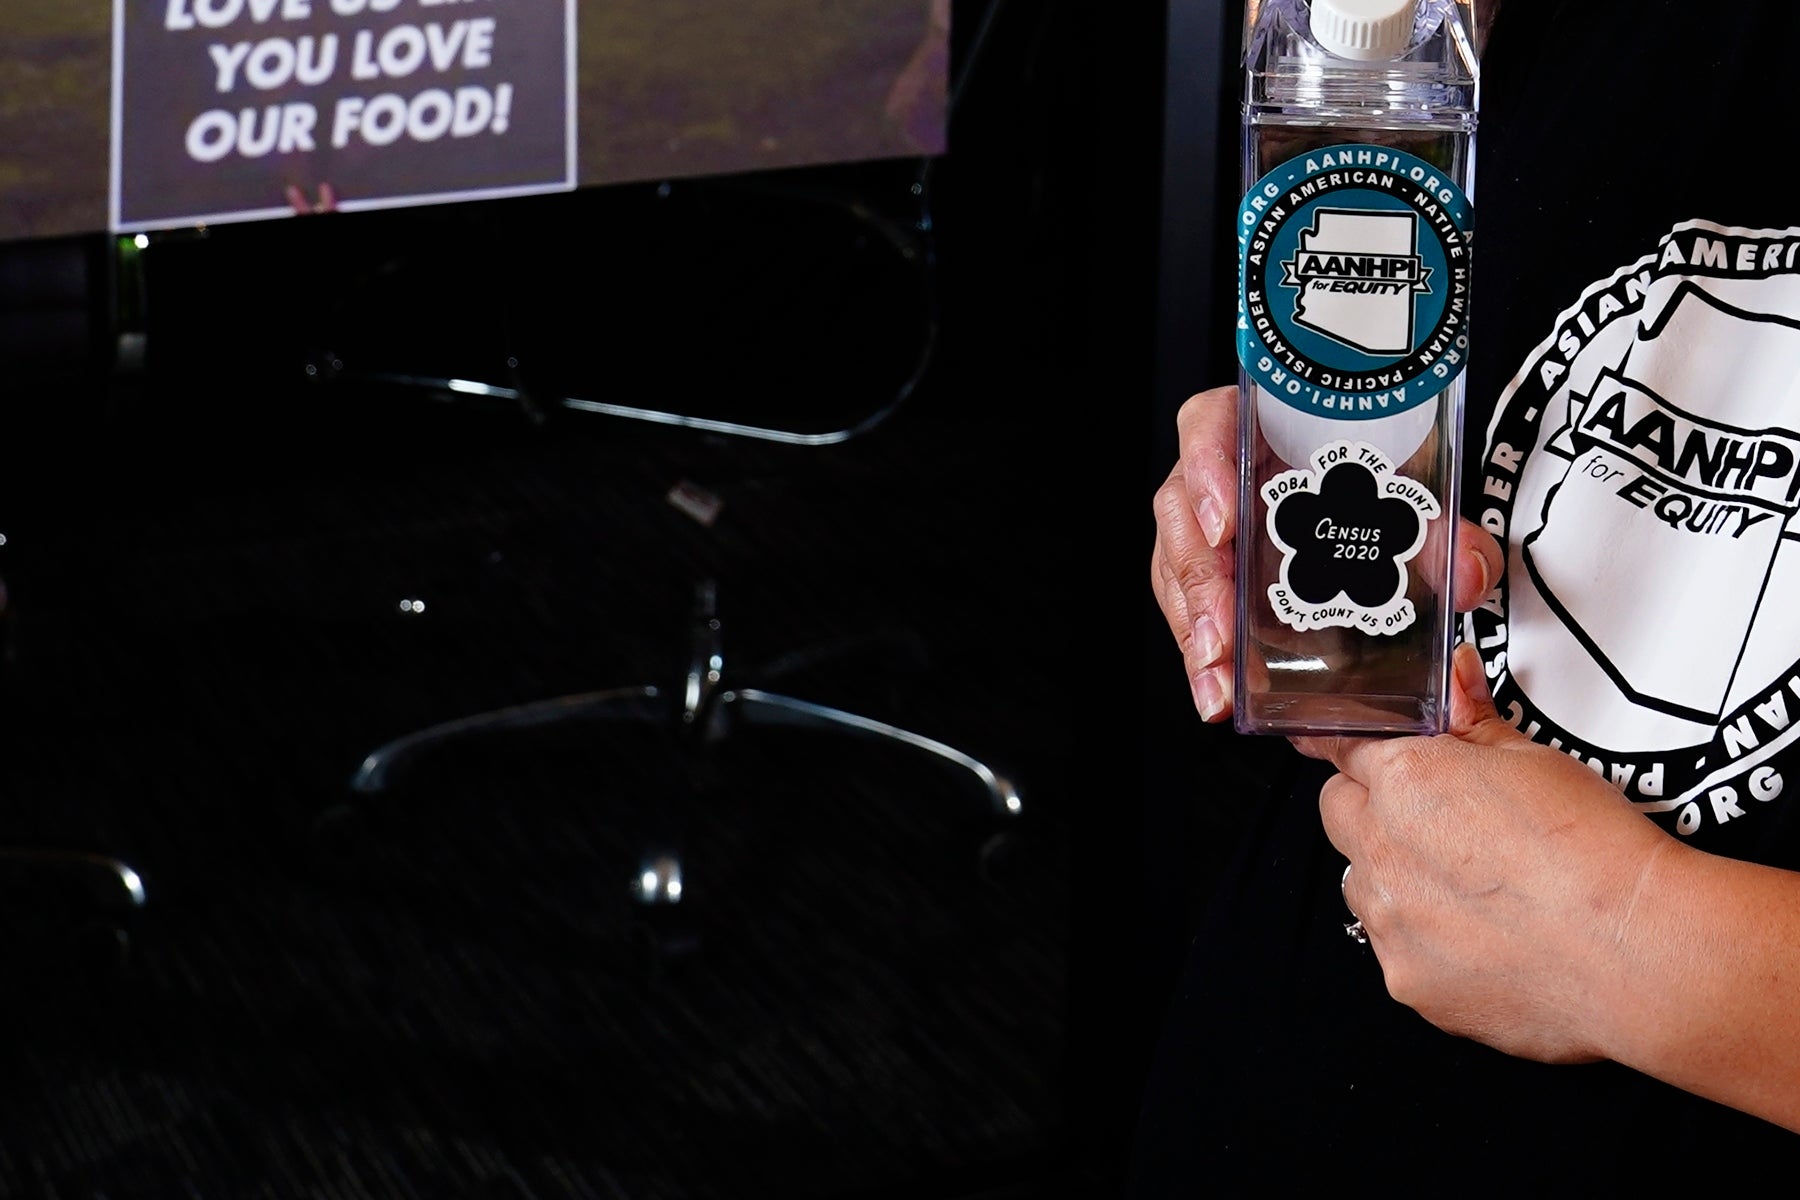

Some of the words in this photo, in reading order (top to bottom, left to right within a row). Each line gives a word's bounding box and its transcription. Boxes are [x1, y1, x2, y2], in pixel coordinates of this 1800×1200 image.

[209, 33, 339, 92] YOU
[351, 17, 496, 80] LOVE
[185, 102, 317, 162] OUR
[331, 82, 514, 148] FOOD!
[1306, 150, 1454, 204] AANHPI.ORG
[1249, 206, 1286, 266] ASIAN
[1289, 171, 1394, 206] AMERICAN
[1414, 192, 1463, 259] NATIVE
[1301, 255, 1417, 279] AANHPI
[1312, 280, 1330, 290] for
[1329, 280, 1408, 295] EQUITY
[1248, 289, 1313, 379] ISLANDER
[1420, 268, 1466, 365] HAWAIIAN
[1540, 270, 1652, 391] ASIAN
[1257, 356, 1406, 411] AANHPI.ORG
[1320, 369, 1404, 390] PACIFIC
[1268, 477, 1309, 501] BOBA
[1317, 446, 1348, 470] FOR
[1358, 448, 1387, 474] THE
[1385, 482, 1434, 512] COUNT
[1582, 455, 1625, 482] for
[1616, 474, 1776, 539] EQUITY
[1333, 544, 1380, 561] 2020
[1275, 589, 1307, 623] DON'T
[1312, 607, 1355, 621] COUNT
[1361, 613, 1379, 627] US
[1385, 605, 1409, 627] OUT
